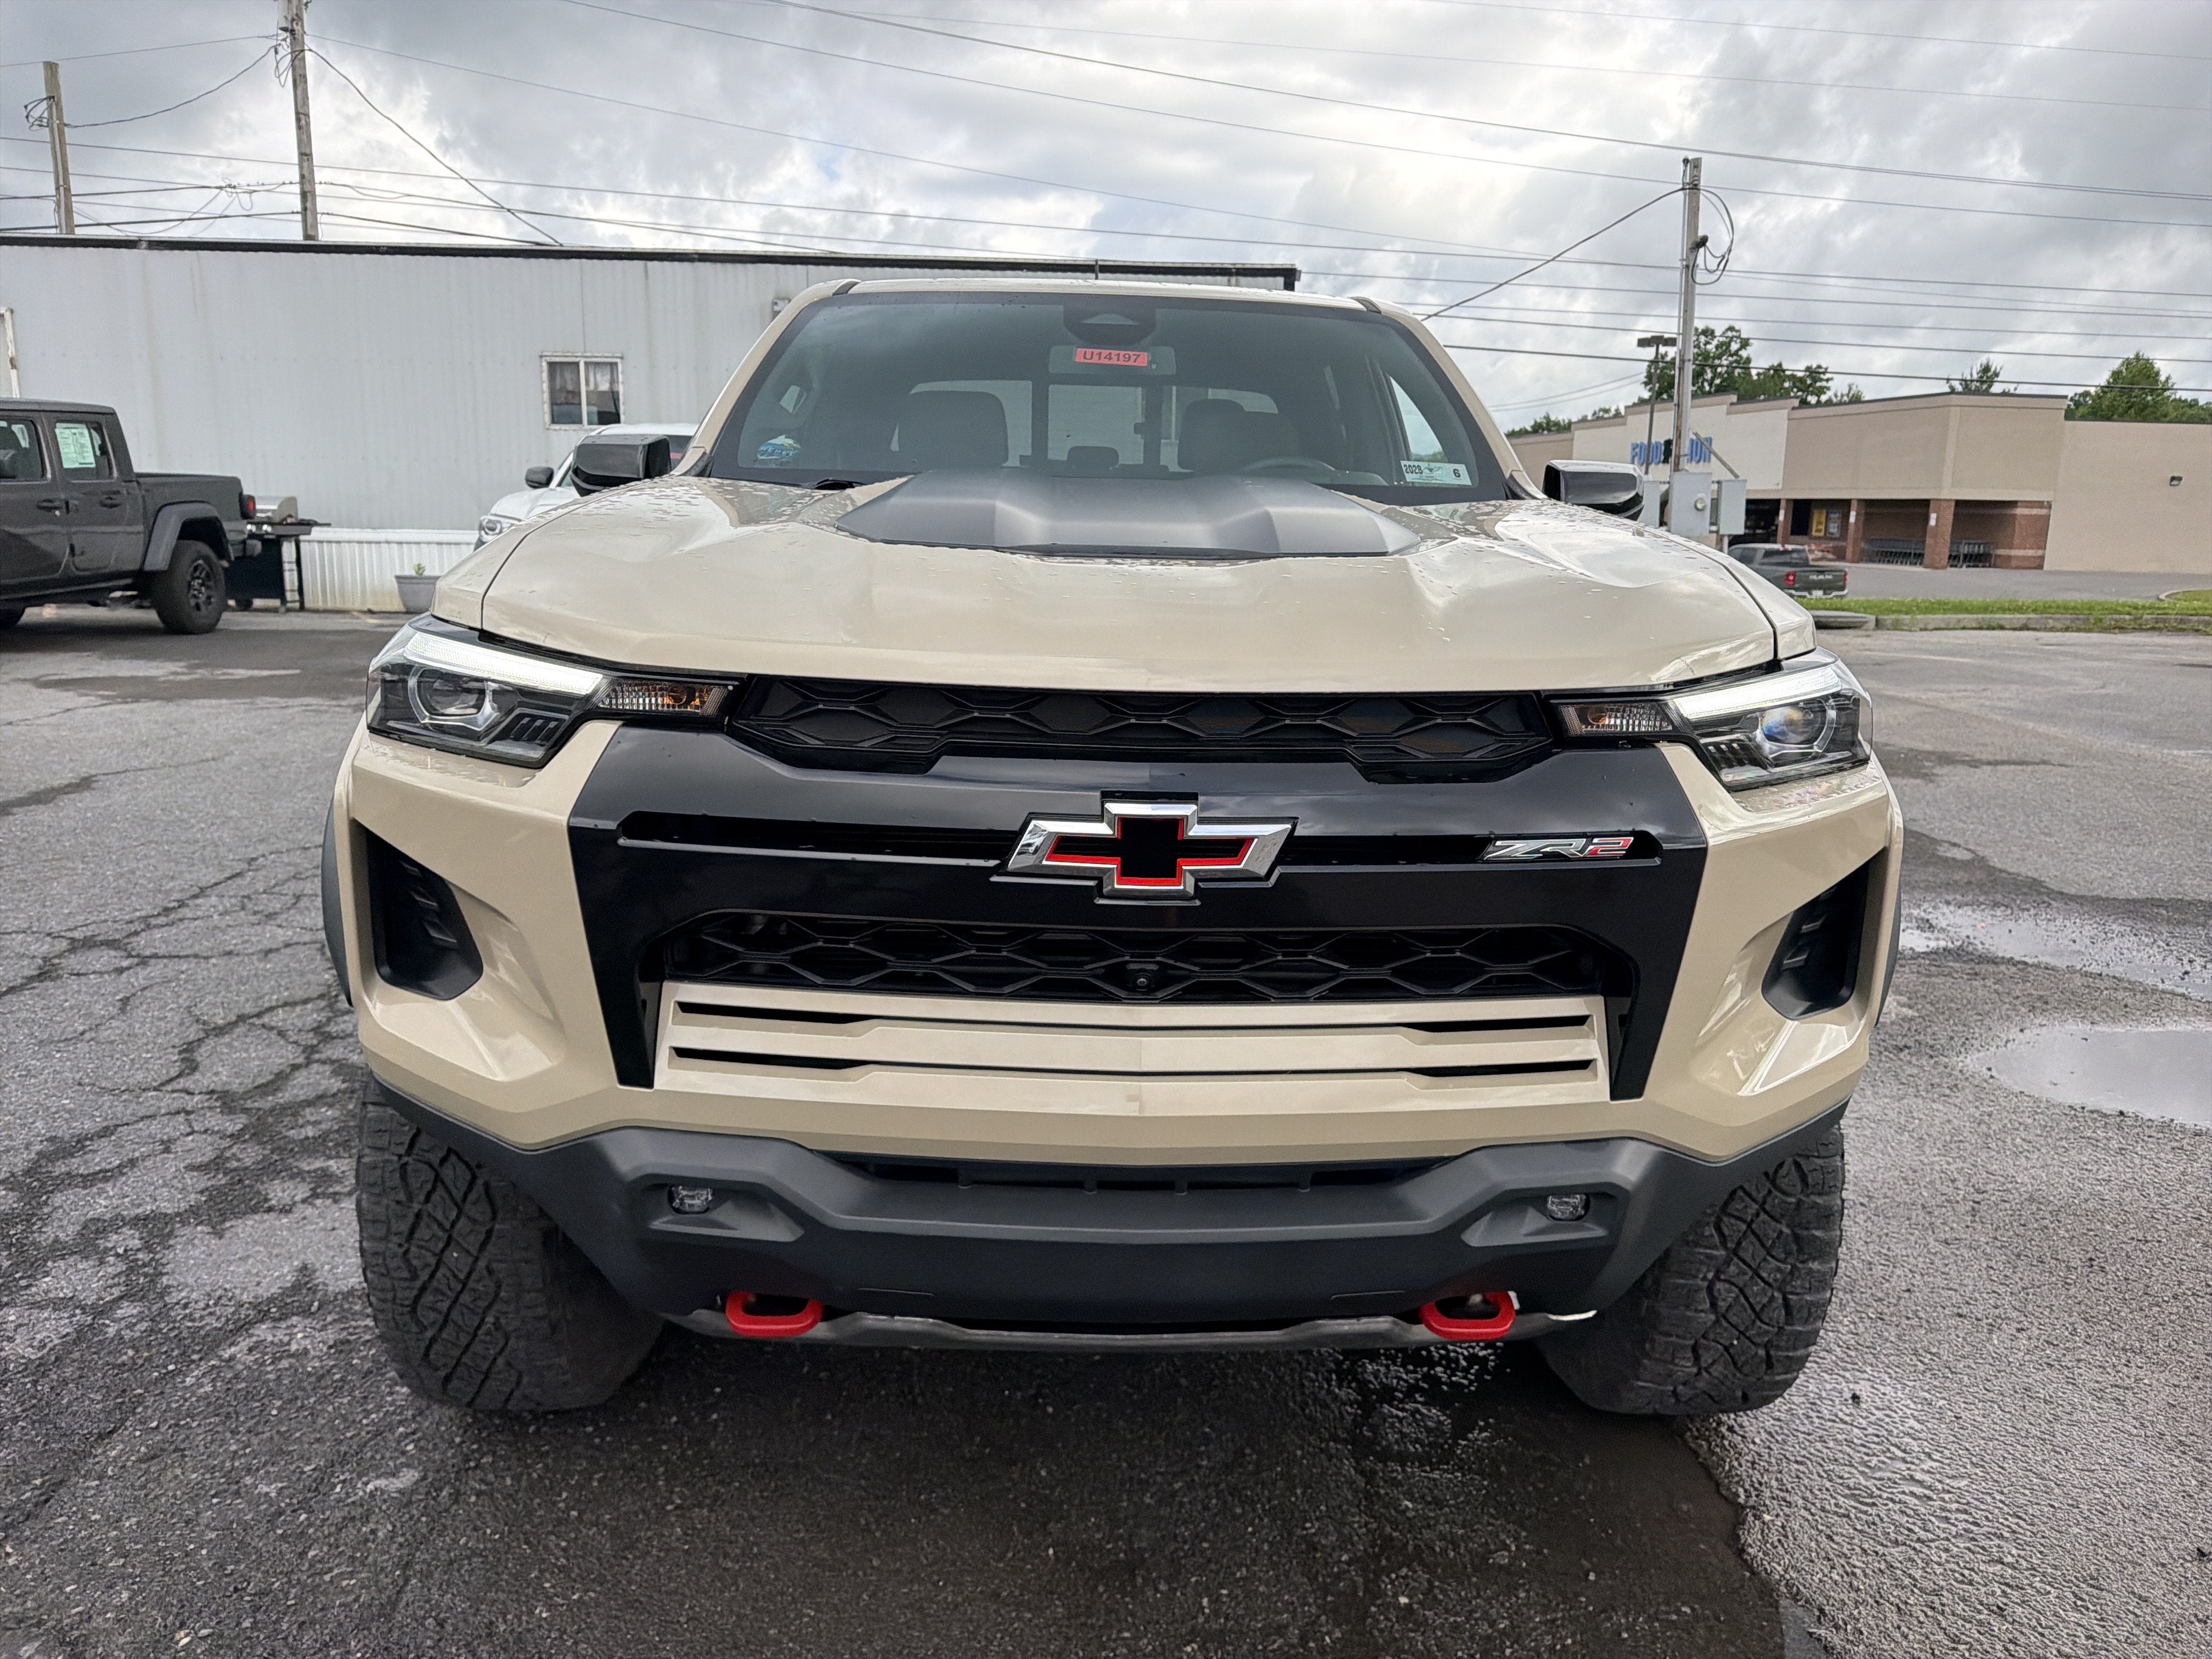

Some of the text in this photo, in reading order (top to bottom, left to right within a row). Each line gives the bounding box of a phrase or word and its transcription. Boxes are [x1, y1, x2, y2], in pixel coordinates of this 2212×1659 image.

[1083, 351, 1141, 363] U14197
[1686, 436, 1712, 464] ION
[1404, 464, 1423, 475] 2028
[1453, 468, 1461, 478] 6
[1482, 837, 1634, 860] ZR2
